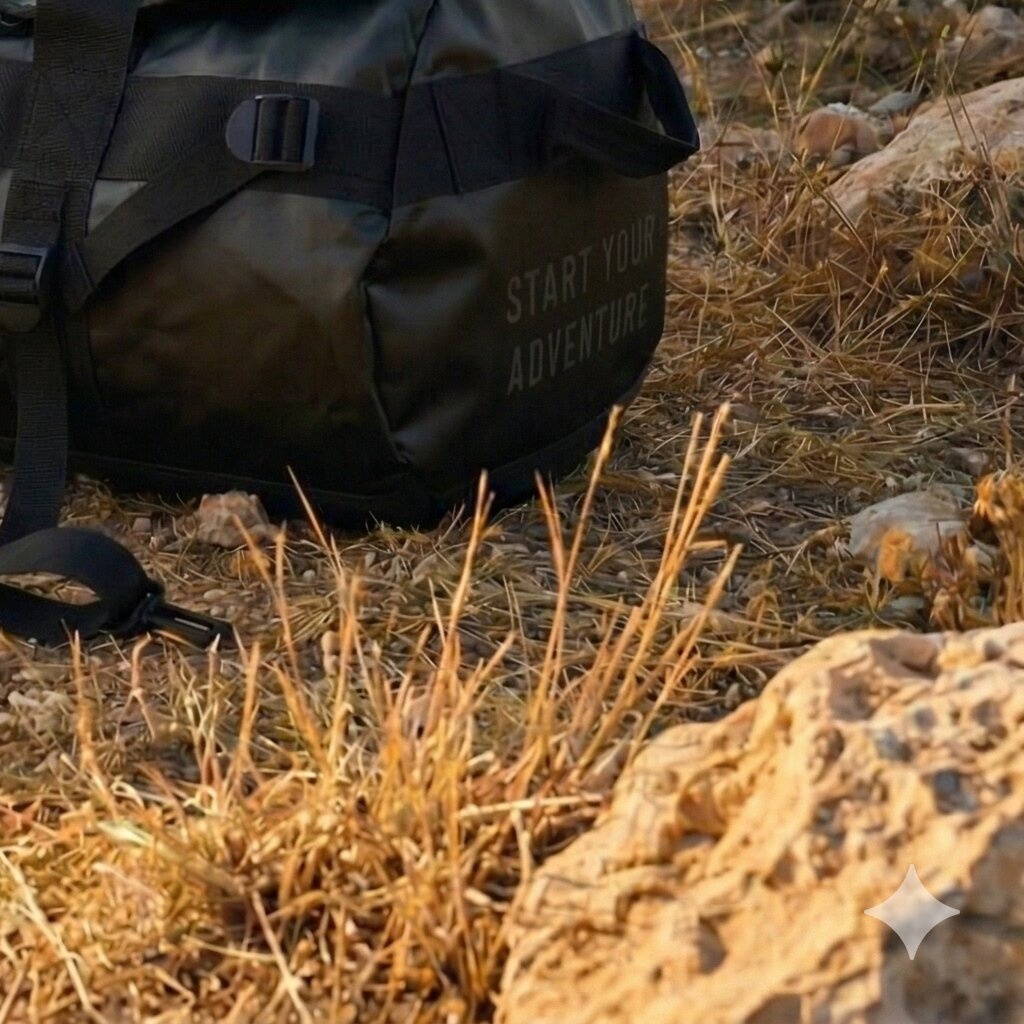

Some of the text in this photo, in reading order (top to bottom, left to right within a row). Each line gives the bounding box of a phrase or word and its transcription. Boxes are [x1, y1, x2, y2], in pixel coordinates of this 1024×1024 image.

[506, 214, 656, 325] START YOUR
[506, 282, 649, 396] ADVENTURE
